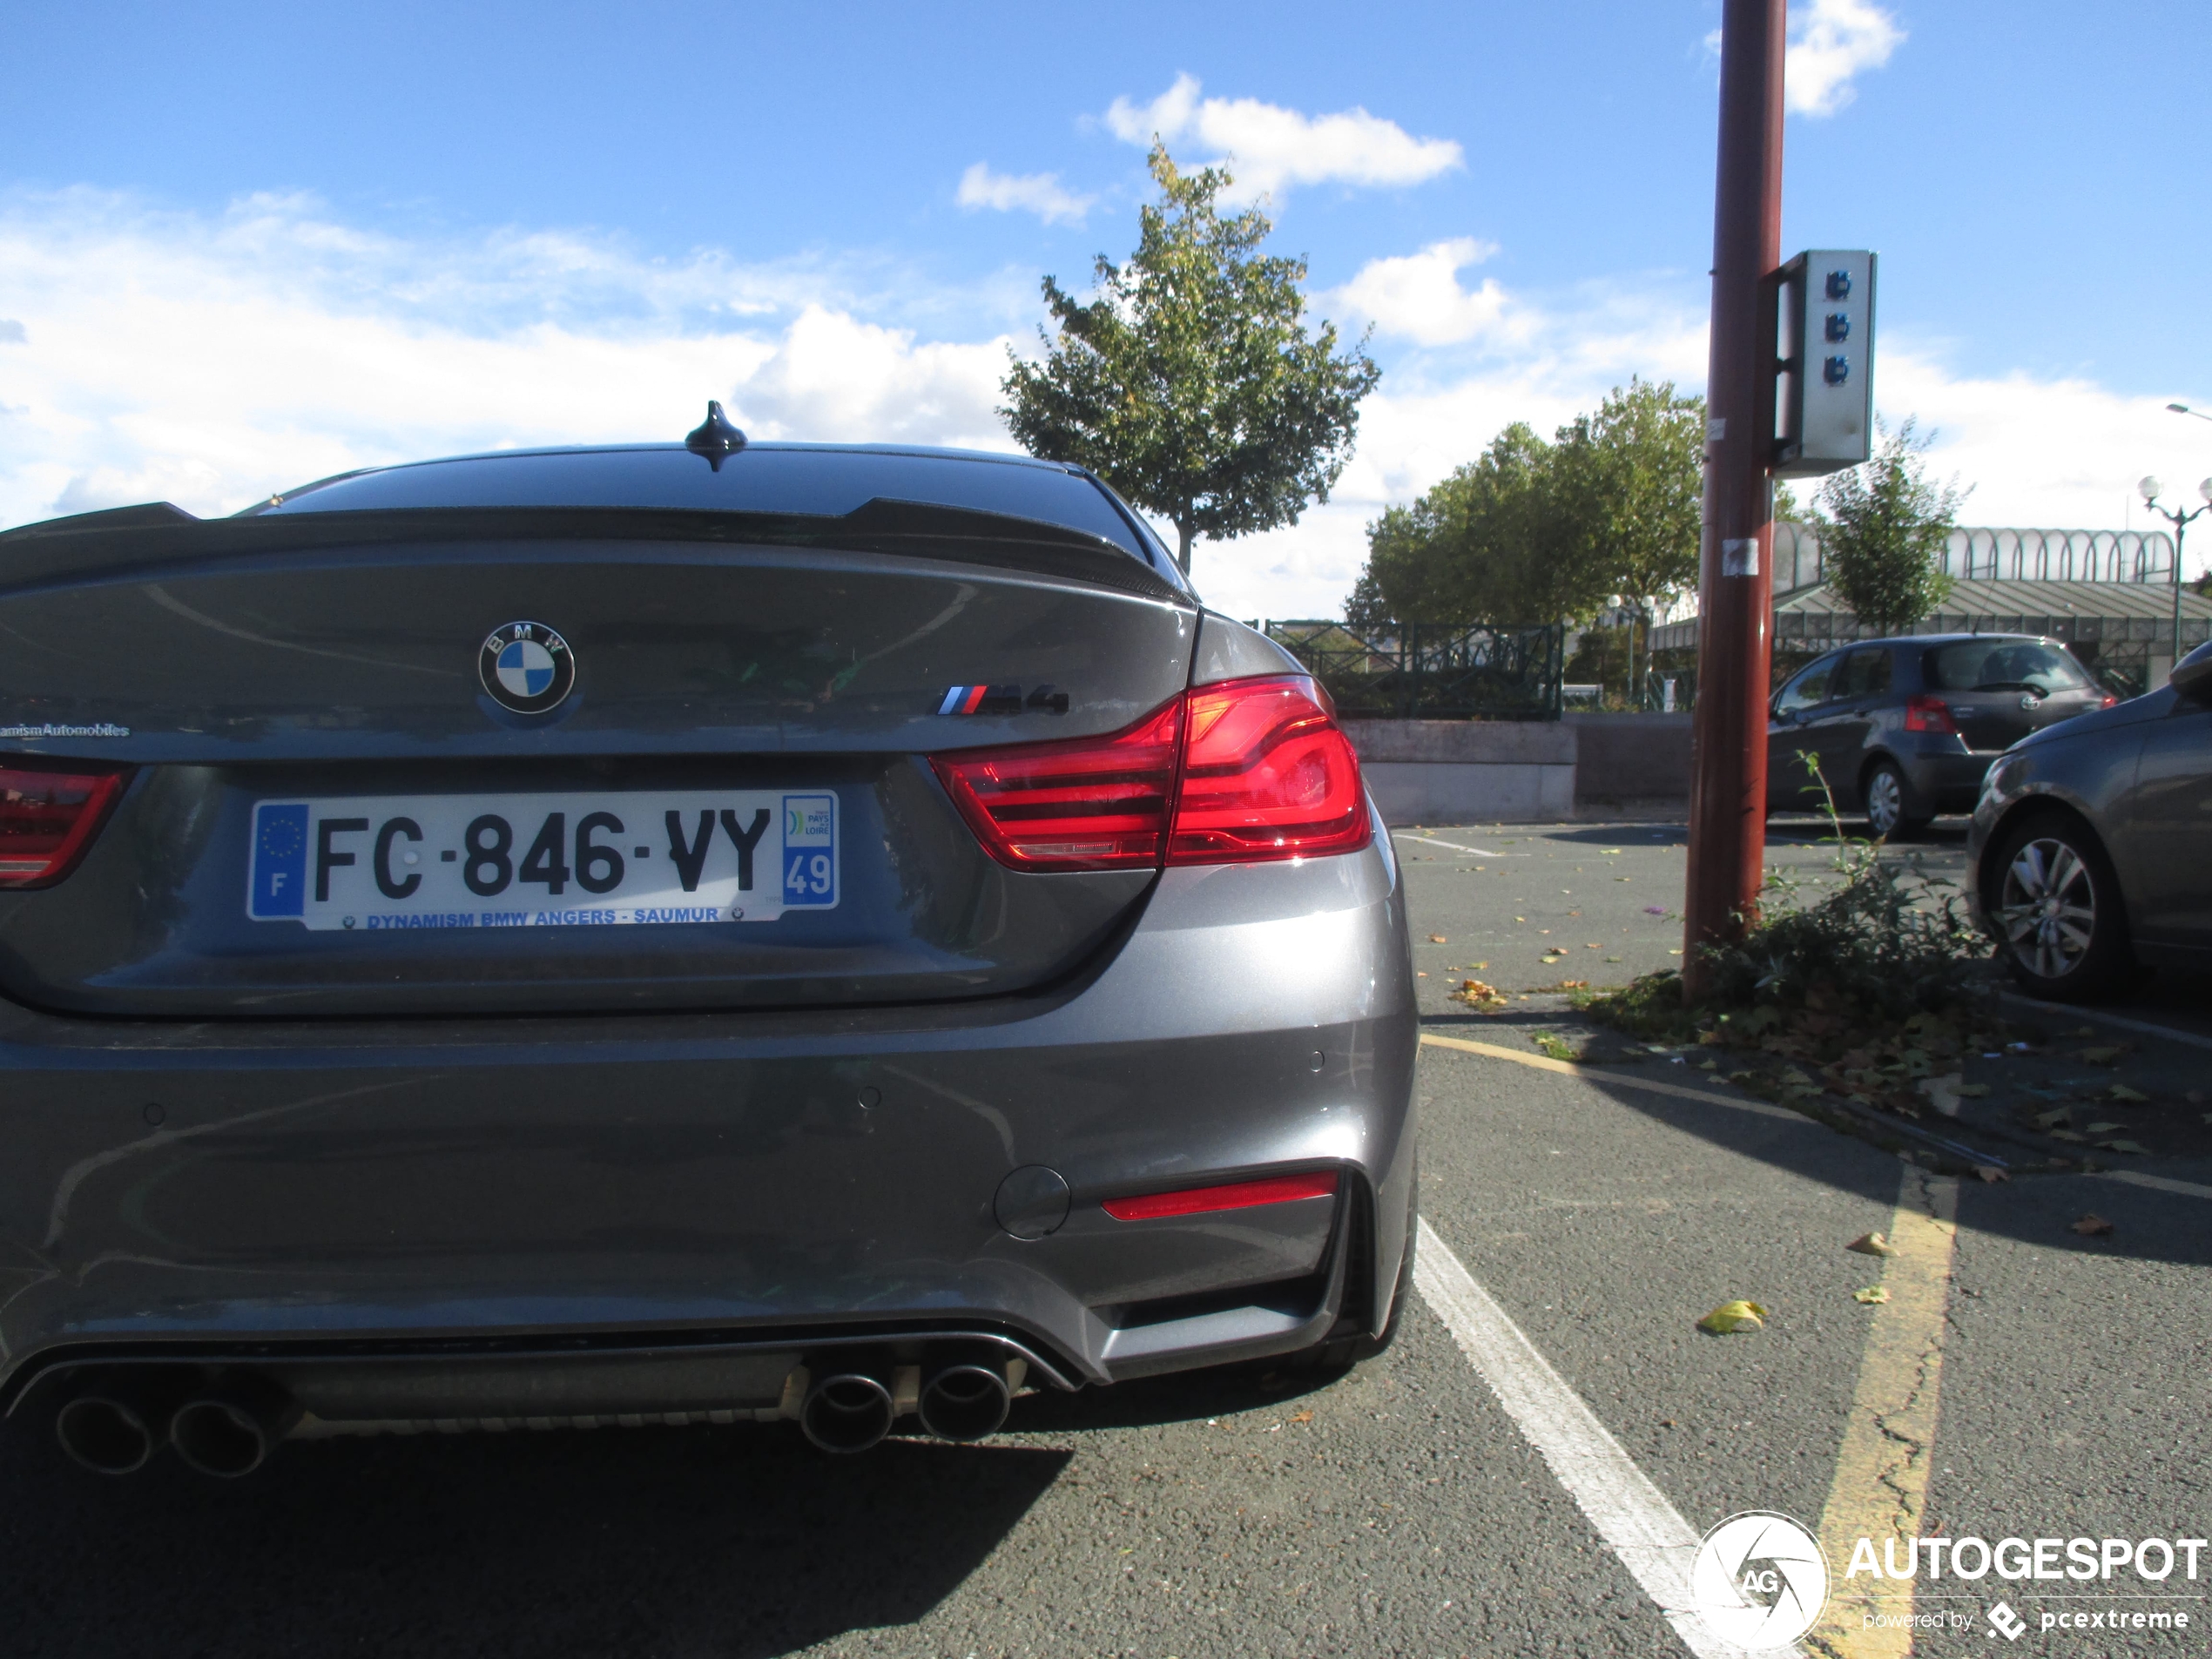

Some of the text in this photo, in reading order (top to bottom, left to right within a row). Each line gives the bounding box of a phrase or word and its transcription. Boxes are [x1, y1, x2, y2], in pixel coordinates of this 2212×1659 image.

[487, 624, 564, 654] BMW
[808, 814, 829, 823] PAYS
[806, 826, 829, 835] LOIRE
[315, 808, 772, 902] FC-846-VY
[272, 873, 287, 896] F
[786, 854, 831, 894] 49
[368, 914, 475, 929] DYNAMISM
[481, 912, 529, 927] BMW
[535, 909, 616, 925] ANGERS
[634, 907, 719, 923] SAUMUR
